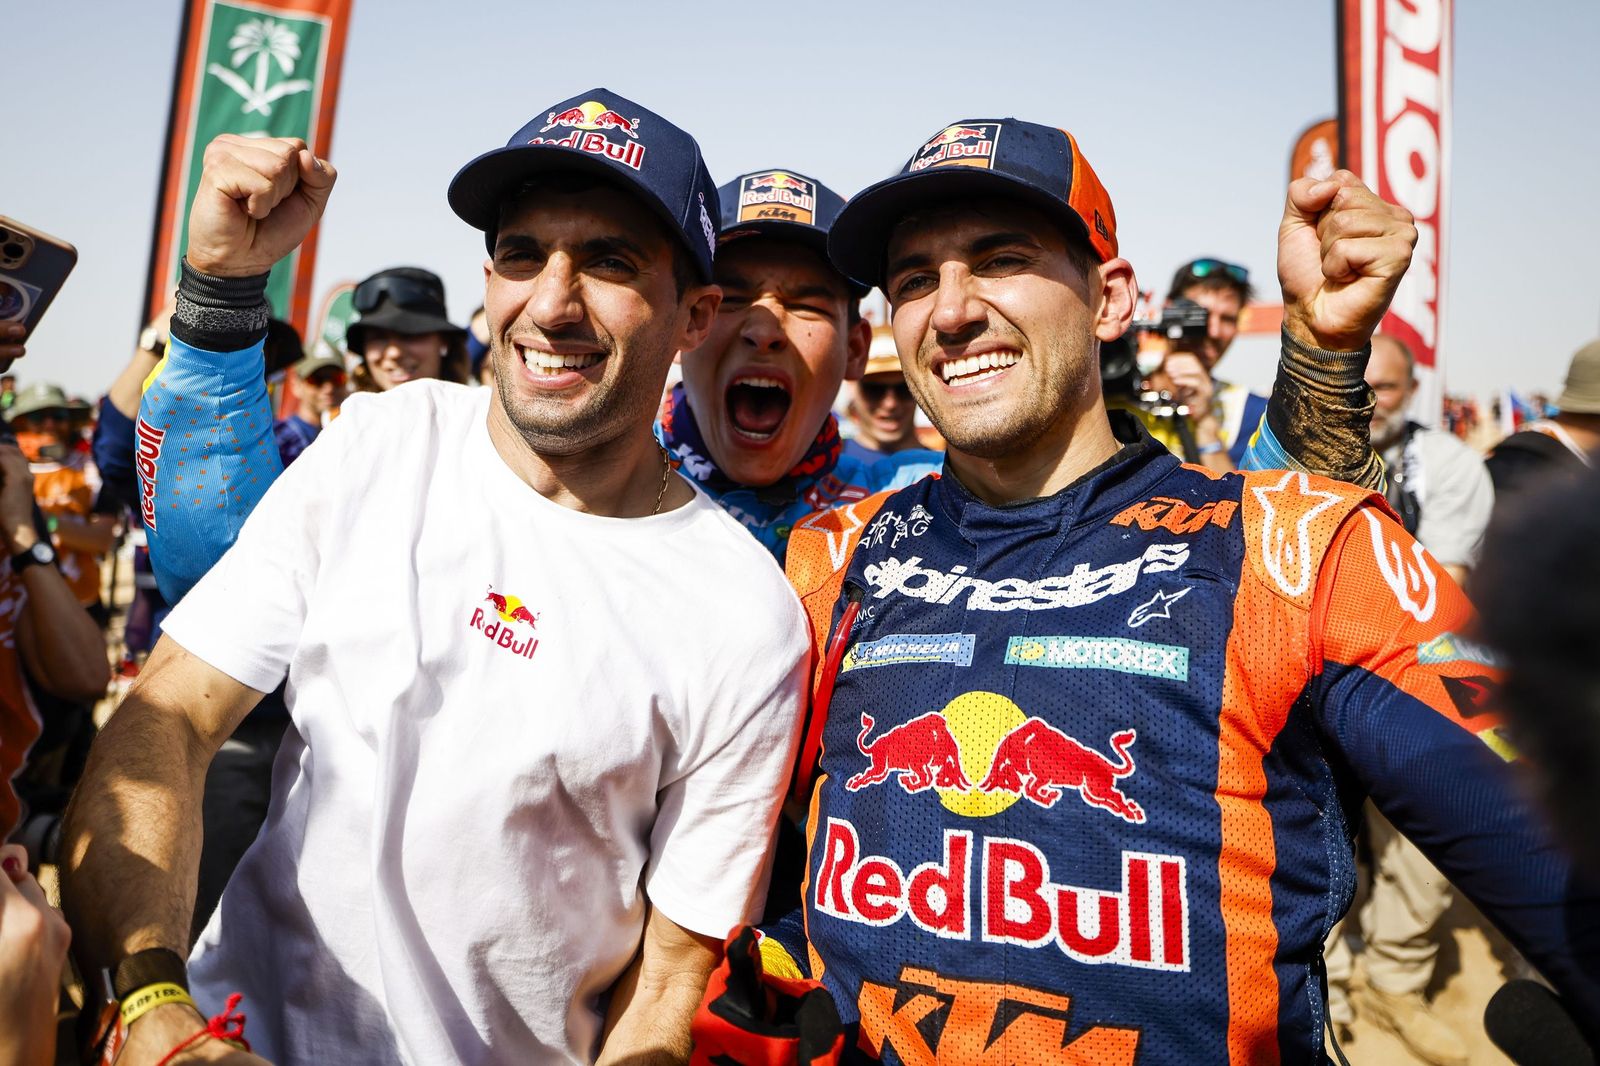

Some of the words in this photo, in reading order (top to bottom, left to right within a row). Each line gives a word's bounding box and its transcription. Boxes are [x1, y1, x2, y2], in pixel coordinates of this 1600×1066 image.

[580, 131, 646, 171] Bull
[911, 144, 947, 172] Red
[947, 140, 993, 158] Bull
[743, 188, 779, 206] Red
[780, 189, 813, 211] Bull
[757, 207, 798, 221] KTM
[136, 416, 166, 480] Bull
[1109, 496, 1239, 535] KTM
[863, 542, 1190, 612] alpinestars
[469, 607, 501, 641] Rd
[496, 626, 539, 660] Bull
[871, 641, 961, 657] MICHELIN
[1047, 640, 1178, 675] MOTOREX
[815, 816, 974, 941] Red
[981, 836, 1191, 973] Bull
[857, 966, 1140, 1066] KTM
